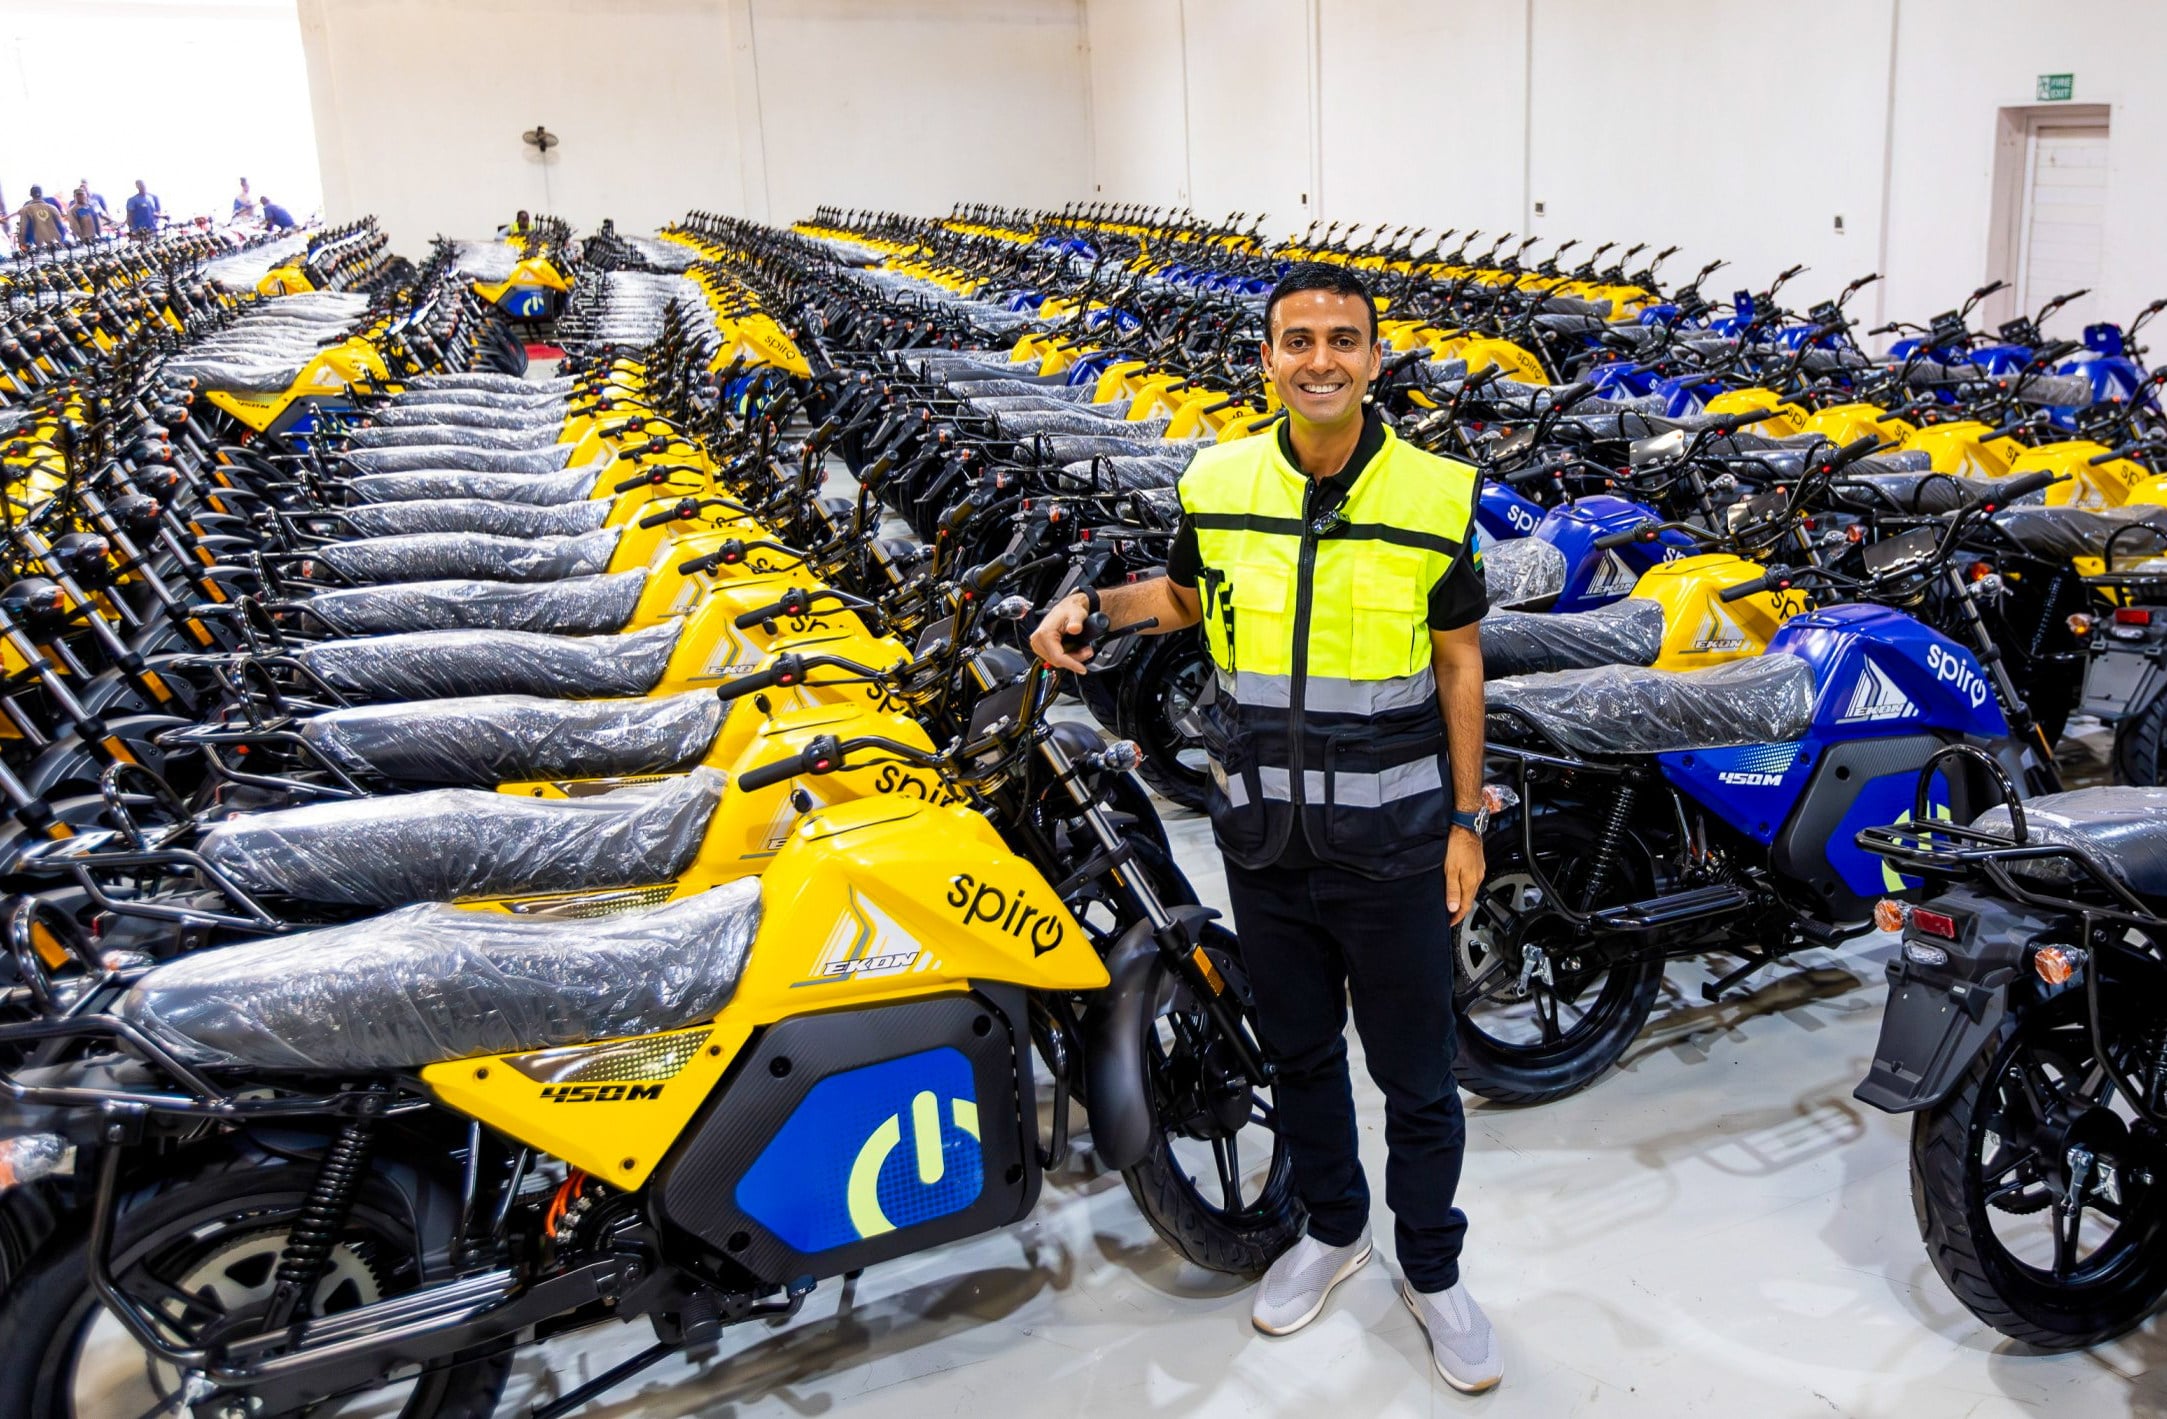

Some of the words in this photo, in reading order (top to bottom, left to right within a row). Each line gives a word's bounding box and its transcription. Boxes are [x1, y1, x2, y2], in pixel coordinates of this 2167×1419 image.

[764, 335, 796, 360] spiro
[1516, 351, 1543, 380] spiro
[1787, 406, 1806, 429] spi
[1507, 504, 1541, 536] spi
[1695, 639, 1743, 649] EKON
[708, 664, 756, 675] EKO
[1926, 643, 1987, 709] spiro
[1855, 703, 1906, 717] EKON
[1718, 771, 1784, 786] 450M
[946, 873, 1064, 958] spiro
[823, 951, 919, 977] EKON
[539, 1083, 665, 1104] 450M
